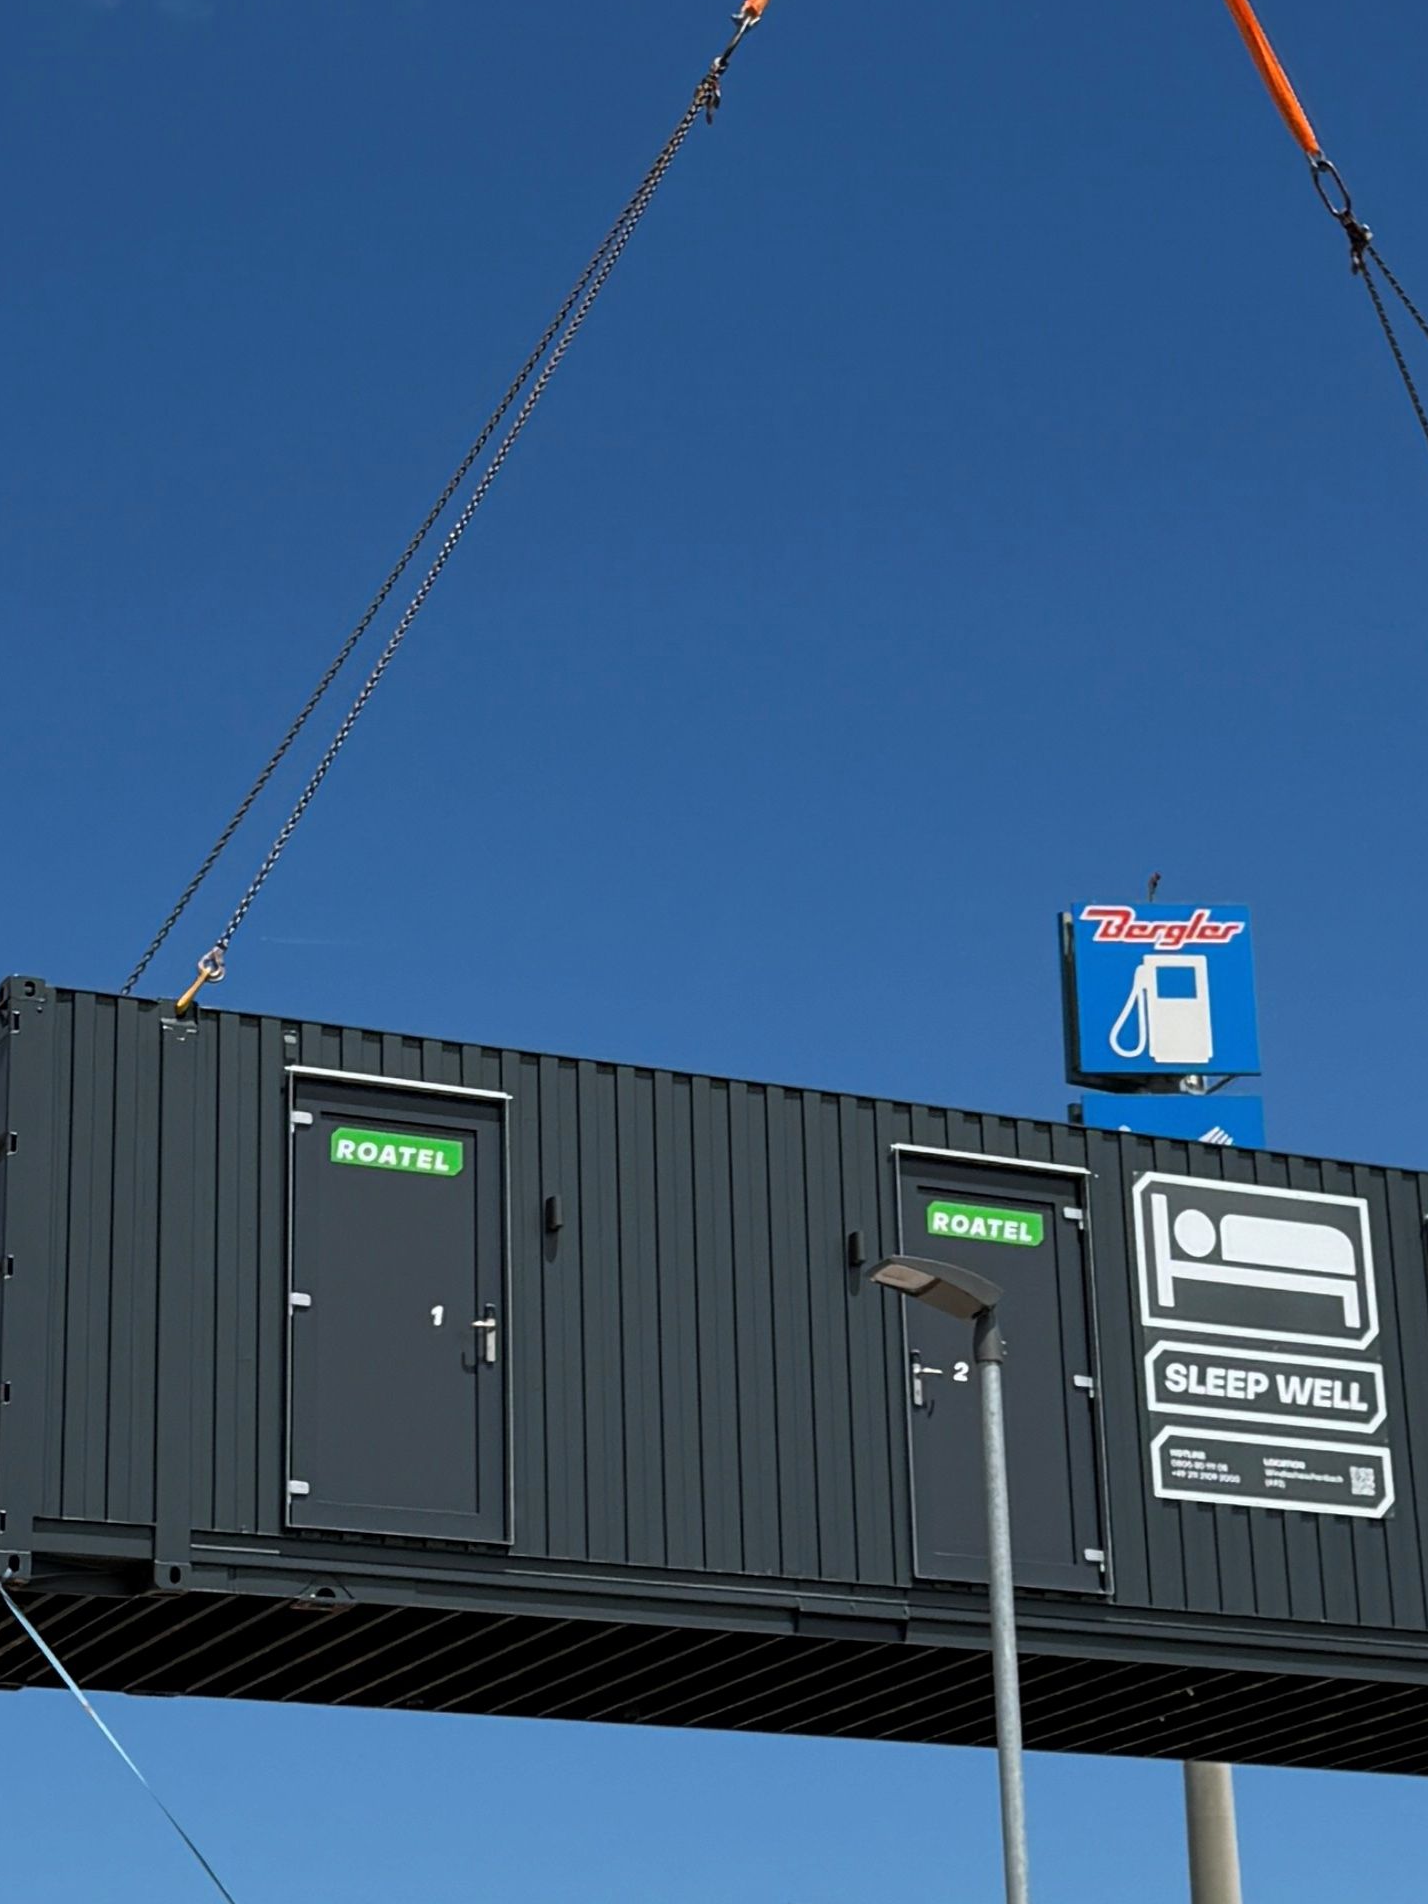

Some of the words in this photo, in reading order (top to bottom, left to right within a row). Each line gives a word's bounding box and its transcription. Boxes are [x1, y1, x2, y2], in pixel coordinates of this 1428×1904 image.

[1079, 905, 1245, 950] Bergler
[336, 1139, 450, 1172] ROATEL
[932, 1210, 1032, 1241] ROATEL
[430, 1304, 444, 1327] 1
[953, 1361, 970, 1382] 2
[1164, 1362, 1269, 1400] SLEEP
[1276, 1374, 1369, 1412] WELL
